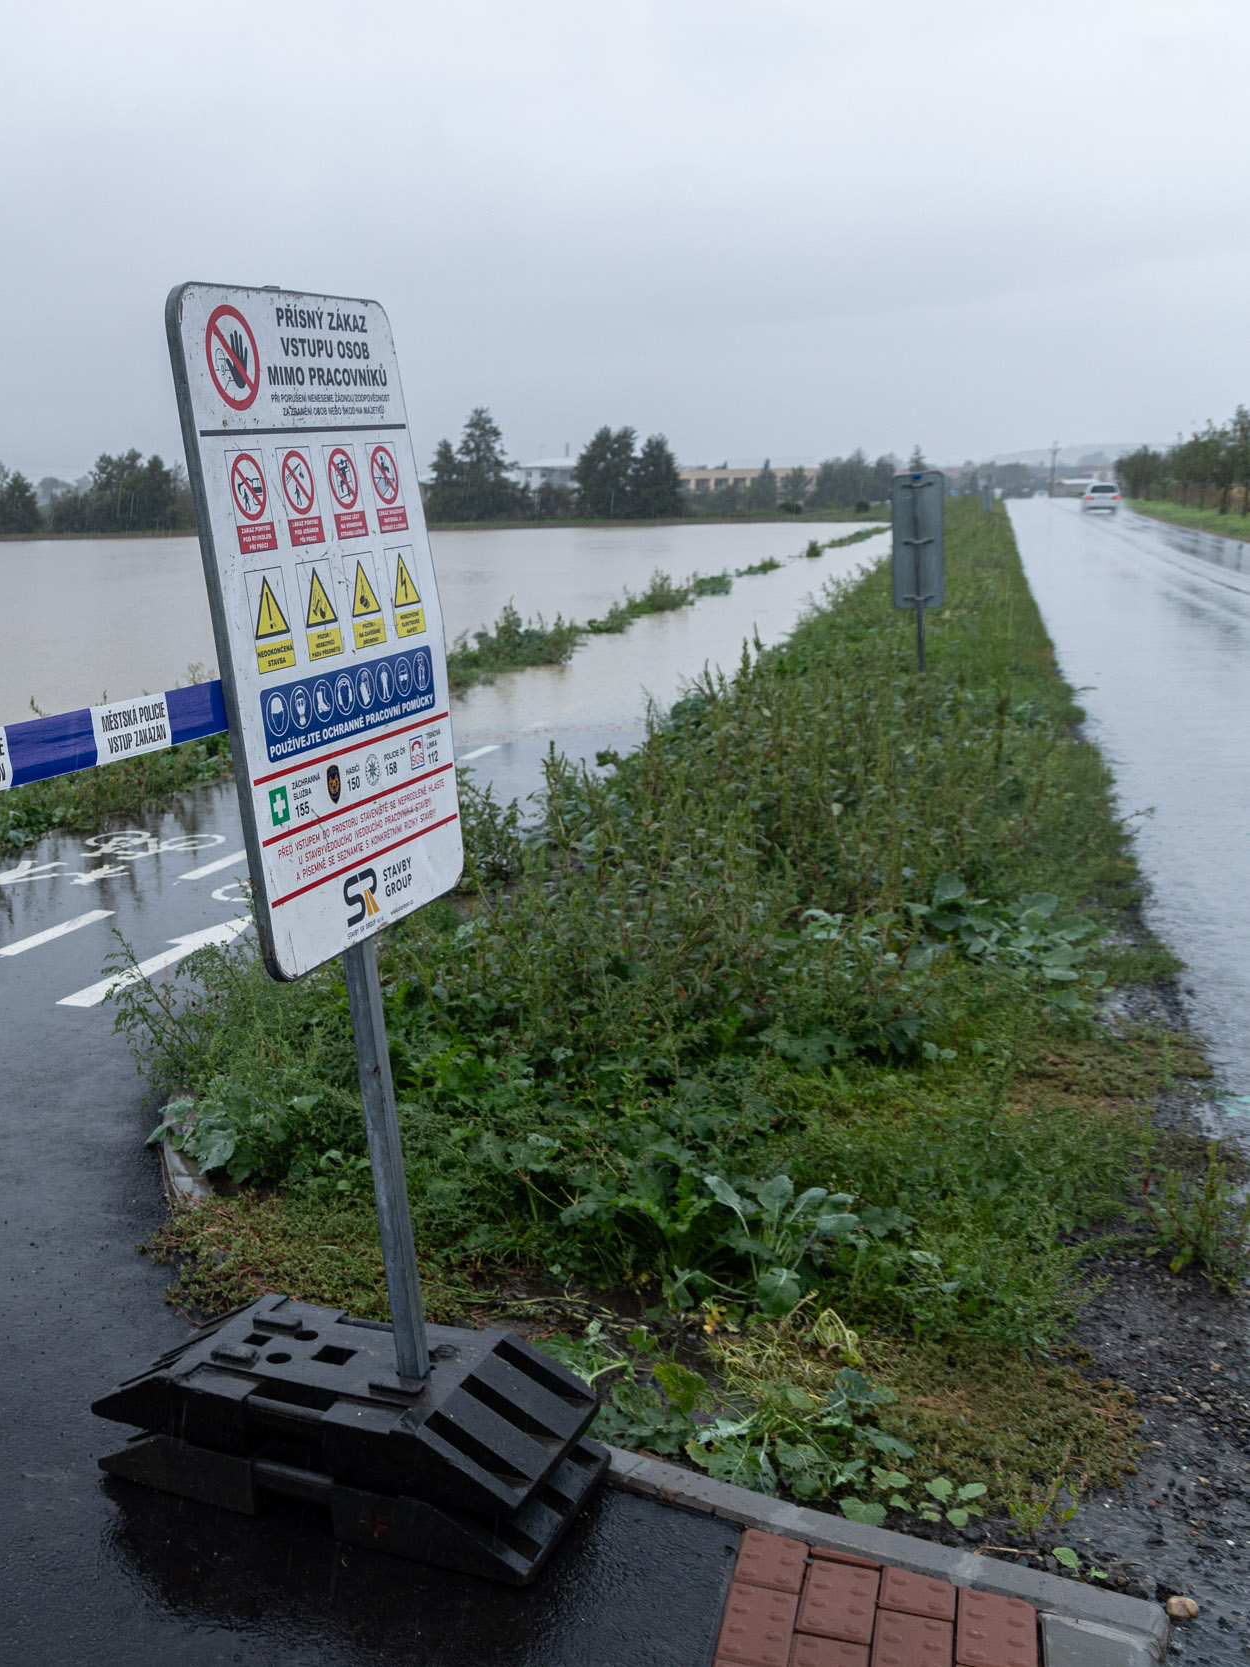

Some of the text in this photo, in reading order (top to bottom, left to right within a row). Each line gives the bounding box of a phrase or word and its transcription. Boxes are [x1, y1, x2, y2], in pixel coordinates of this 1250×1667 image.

[276, 303, 368, 333] PŘÍSNÝ ZÁKAZ
[280, 337, 370, 360] VSTUPU OSOB
[267, 363, 388, 387] MIMO PRACOVNÍKŮ
[308, 394, 334, 402] NENESEME
[257, 643, 294, 658] NEDOKONČENÁ
[268, 656, 286, 668] STAVBA
[101, 702, 166, 733] MĚSTSKÁ POLICIE
[270, 694, 434, 758] POUŽÍVEJTE OCHRANNÉ PRACOVNÍ POMŮCKY
[107, 722, 167, 754] VSTUP ZAKÁZÁN
[384, 750, 399, 762] POLICIE
[412, 752, 424, 766] SOS
[428, 750, 438, 764] 112
[346, 763, 360, 776] HASIČI
[385, 762, 398, 776] 158
[292, 772, 320, 790] ZÁCHRANNÁ
[347, 776, 360, 792] 150
[293, 788, 312, 801] SLUŽBA
[295, 801, 310, 818] 155
[278, 844, 294, 860] PŘED
[295, 832, 320, 852] VSTUPEM
[322, 828, 330, 840] DO
[332, 816, 358, 835] PROSTORU
[390, 800, 396, 810] SE
[298, 856, 303, 865] U
[304, 832, 352, 862] STAVBYVEDOUCÍHO
[296, 872, 301, 882] A
[302, 858, 326, 878] PÍSEMNĚ
[328, 855, 335, 866] SE
[336, 842, 364, 862] SEZNAMTE
[366, 840, 369, 848] S
[382, 856, 412, 882] STAVBY
[385, 874, 412, 898] GROUP
